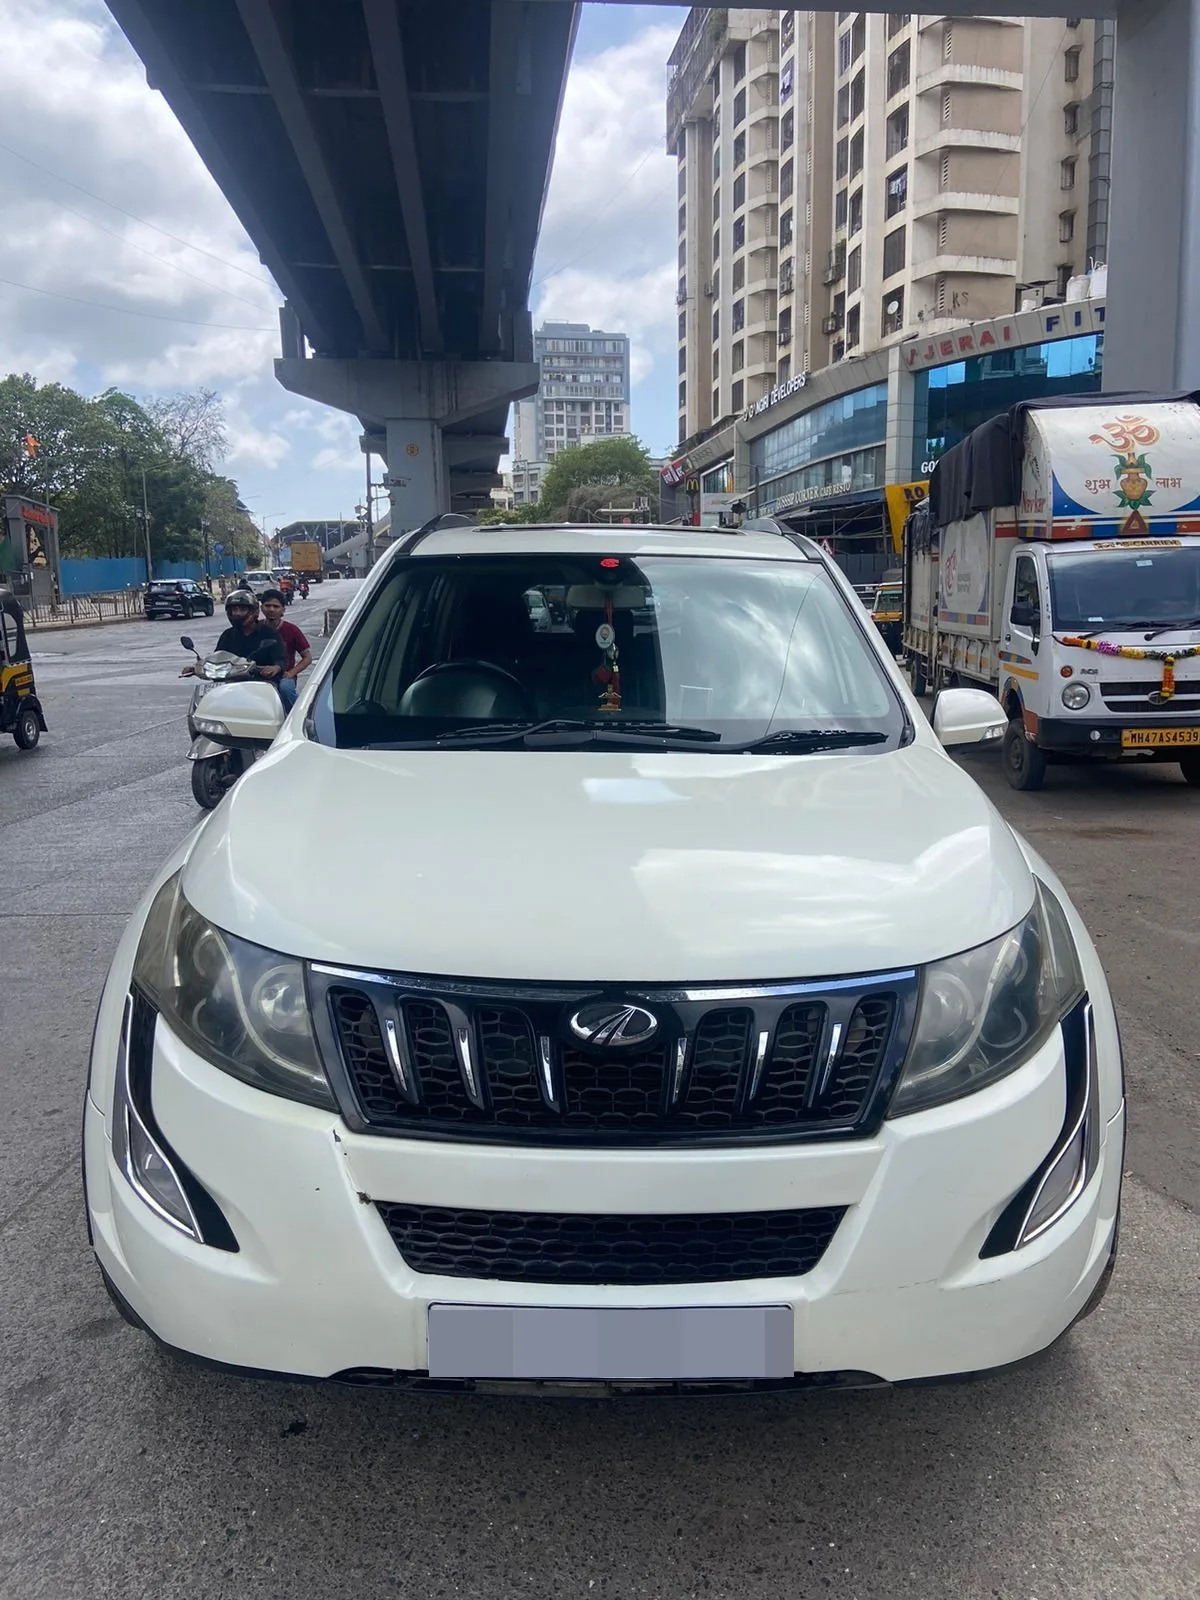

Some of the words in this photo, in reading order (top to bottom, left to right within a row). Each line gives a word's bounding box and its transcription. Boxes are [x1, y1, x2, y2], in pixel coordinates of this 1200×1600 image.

[924, 326, 1011, 360] JERAI
[770, 371, 806, 406] DEVELOPERS
[1084, 478, 1112, 495] शुभ
[1155, 476, 1183, 489] लाभ
[1130, 731, 1199, 744] MH47AS4539
